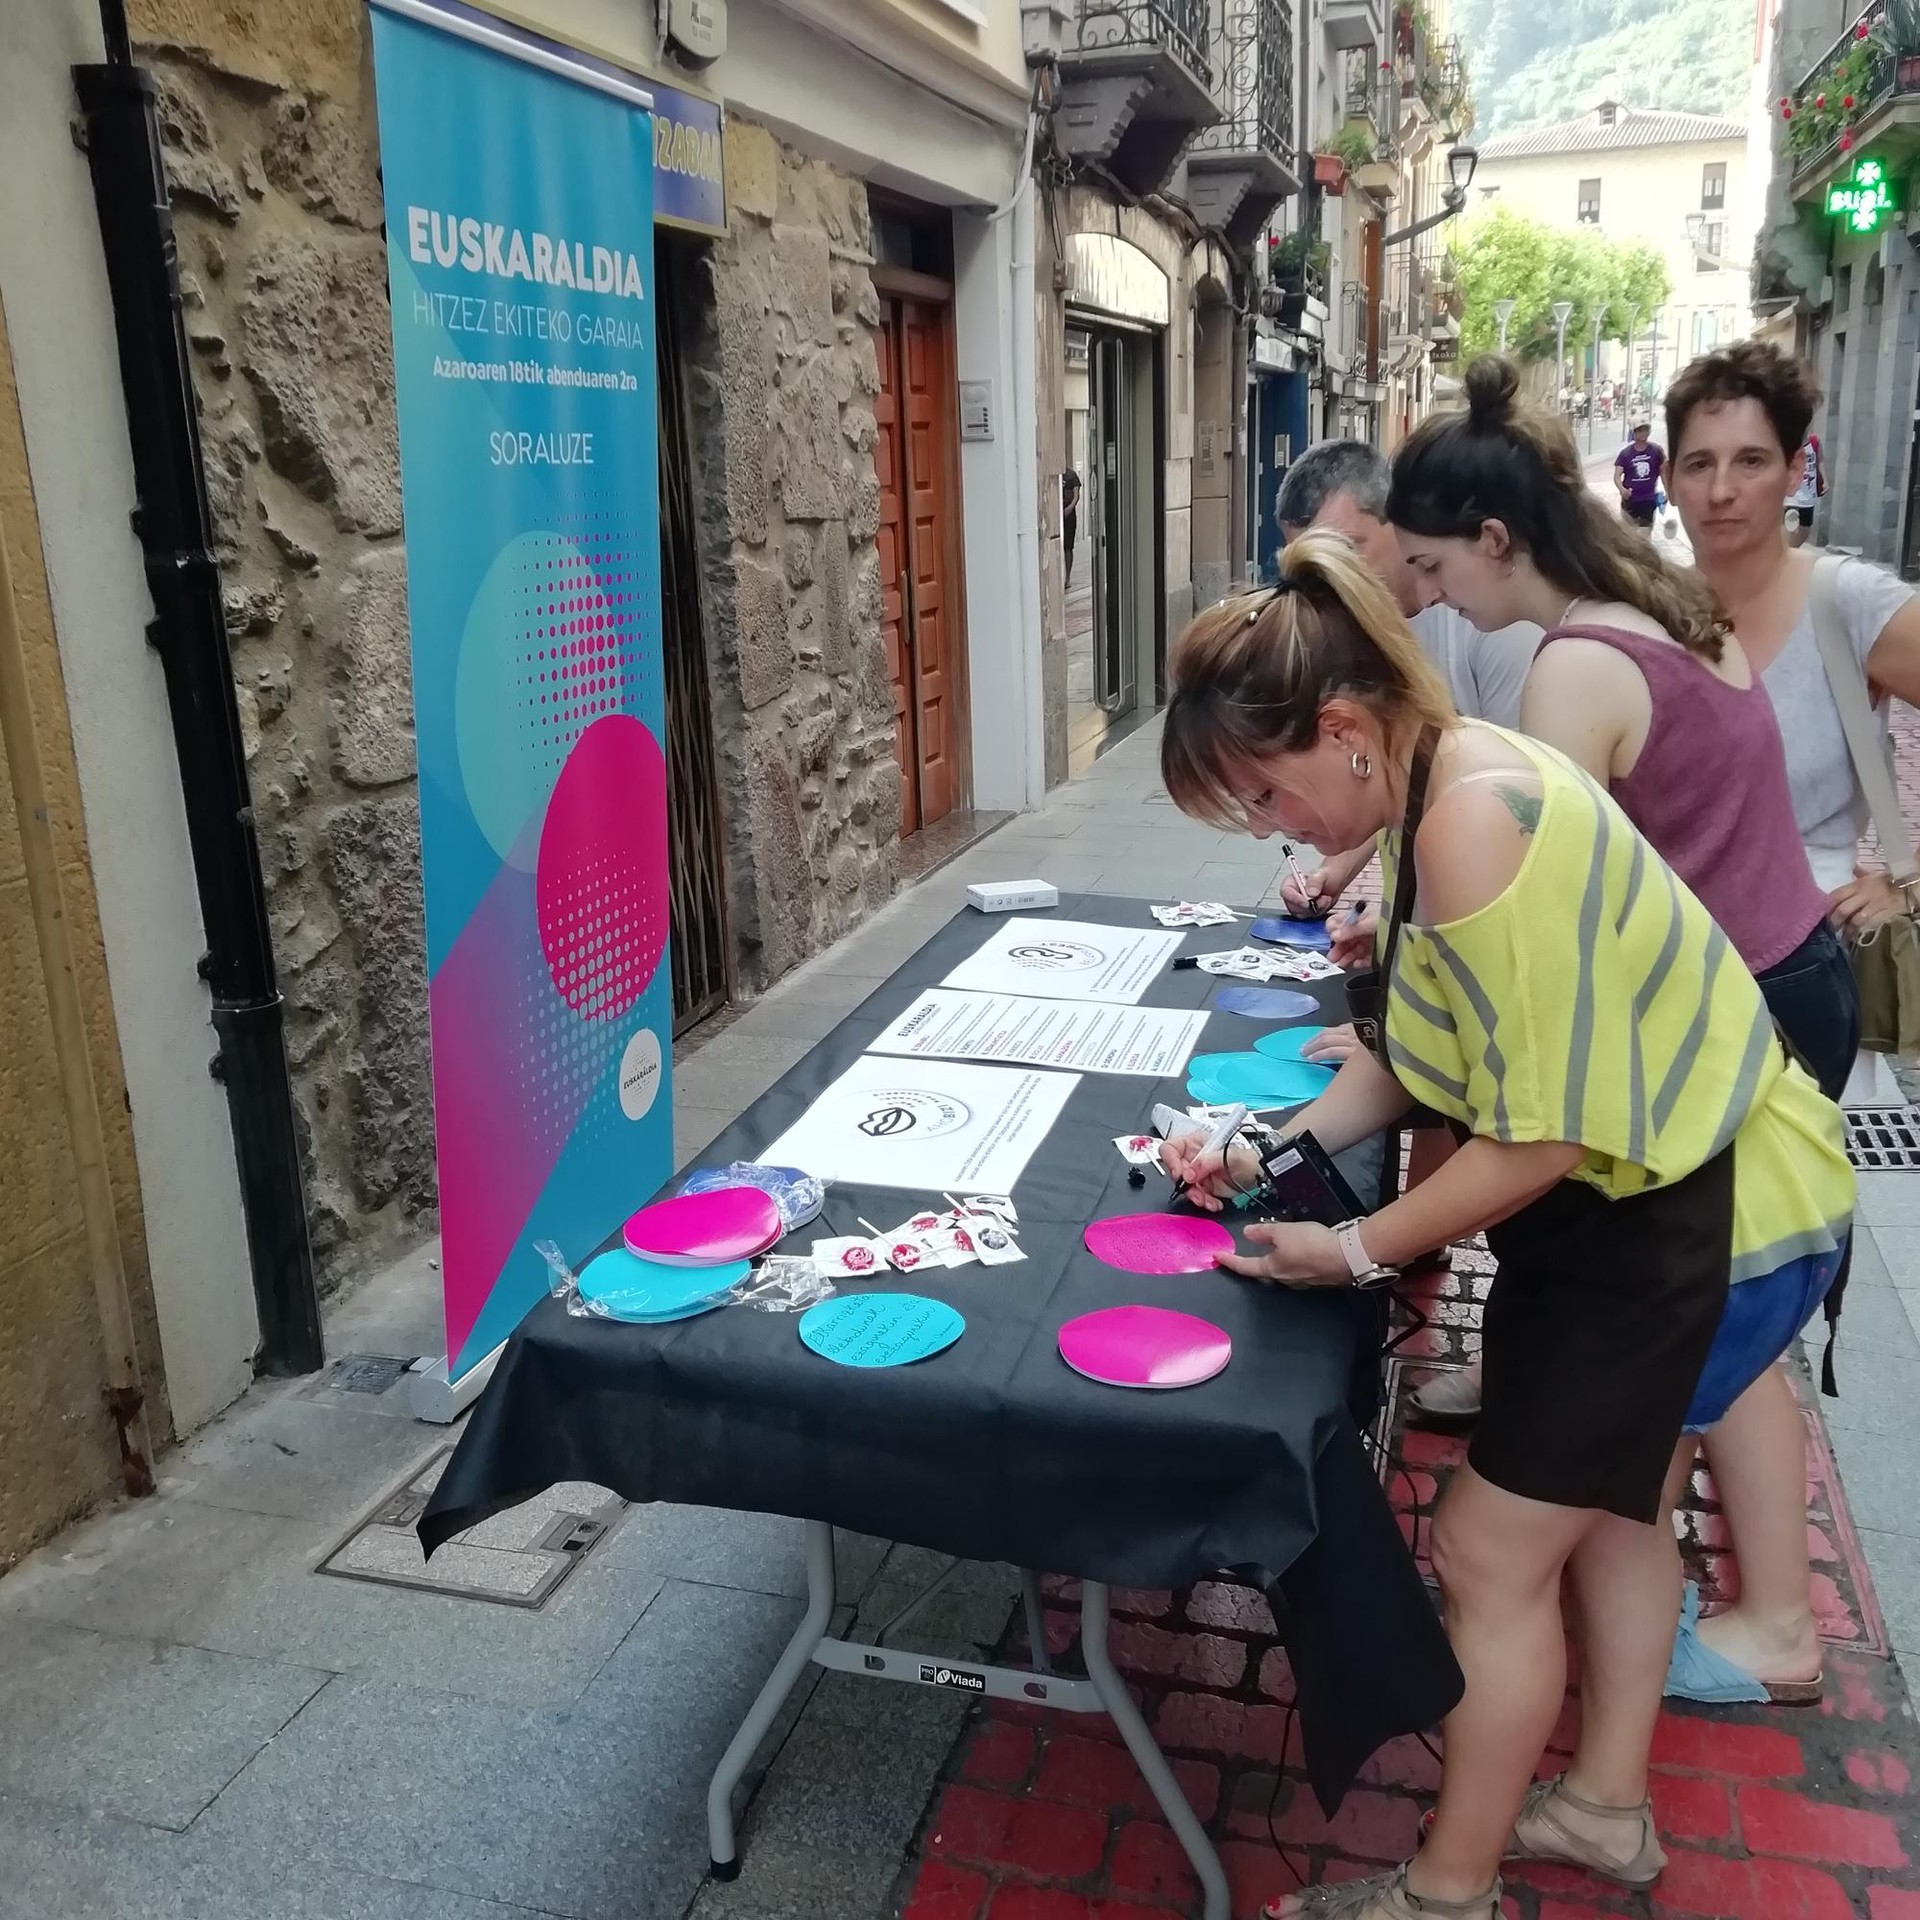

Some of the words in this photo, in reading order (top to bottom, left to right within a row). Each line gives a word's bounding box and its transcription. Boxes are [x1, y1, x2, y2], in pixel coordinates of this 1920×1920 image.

[408, 205, 644, 300] EUSKARALDIA
[412, 290, 489, 333] HITZEZ
[494, 301, 572, 342] EKITEKO
[576, 313, 644, 350] GARAIA
[433, 355, 507, 382] Azaroaren
[508, 359, 545, 384] 18tik
[547, 364, 618, 390] abenduaren
[620, 370, 638, 391] 2ra
[490, 431, 594, 466] SORALUZE
[951, 1673, 983, 1689] Viada
